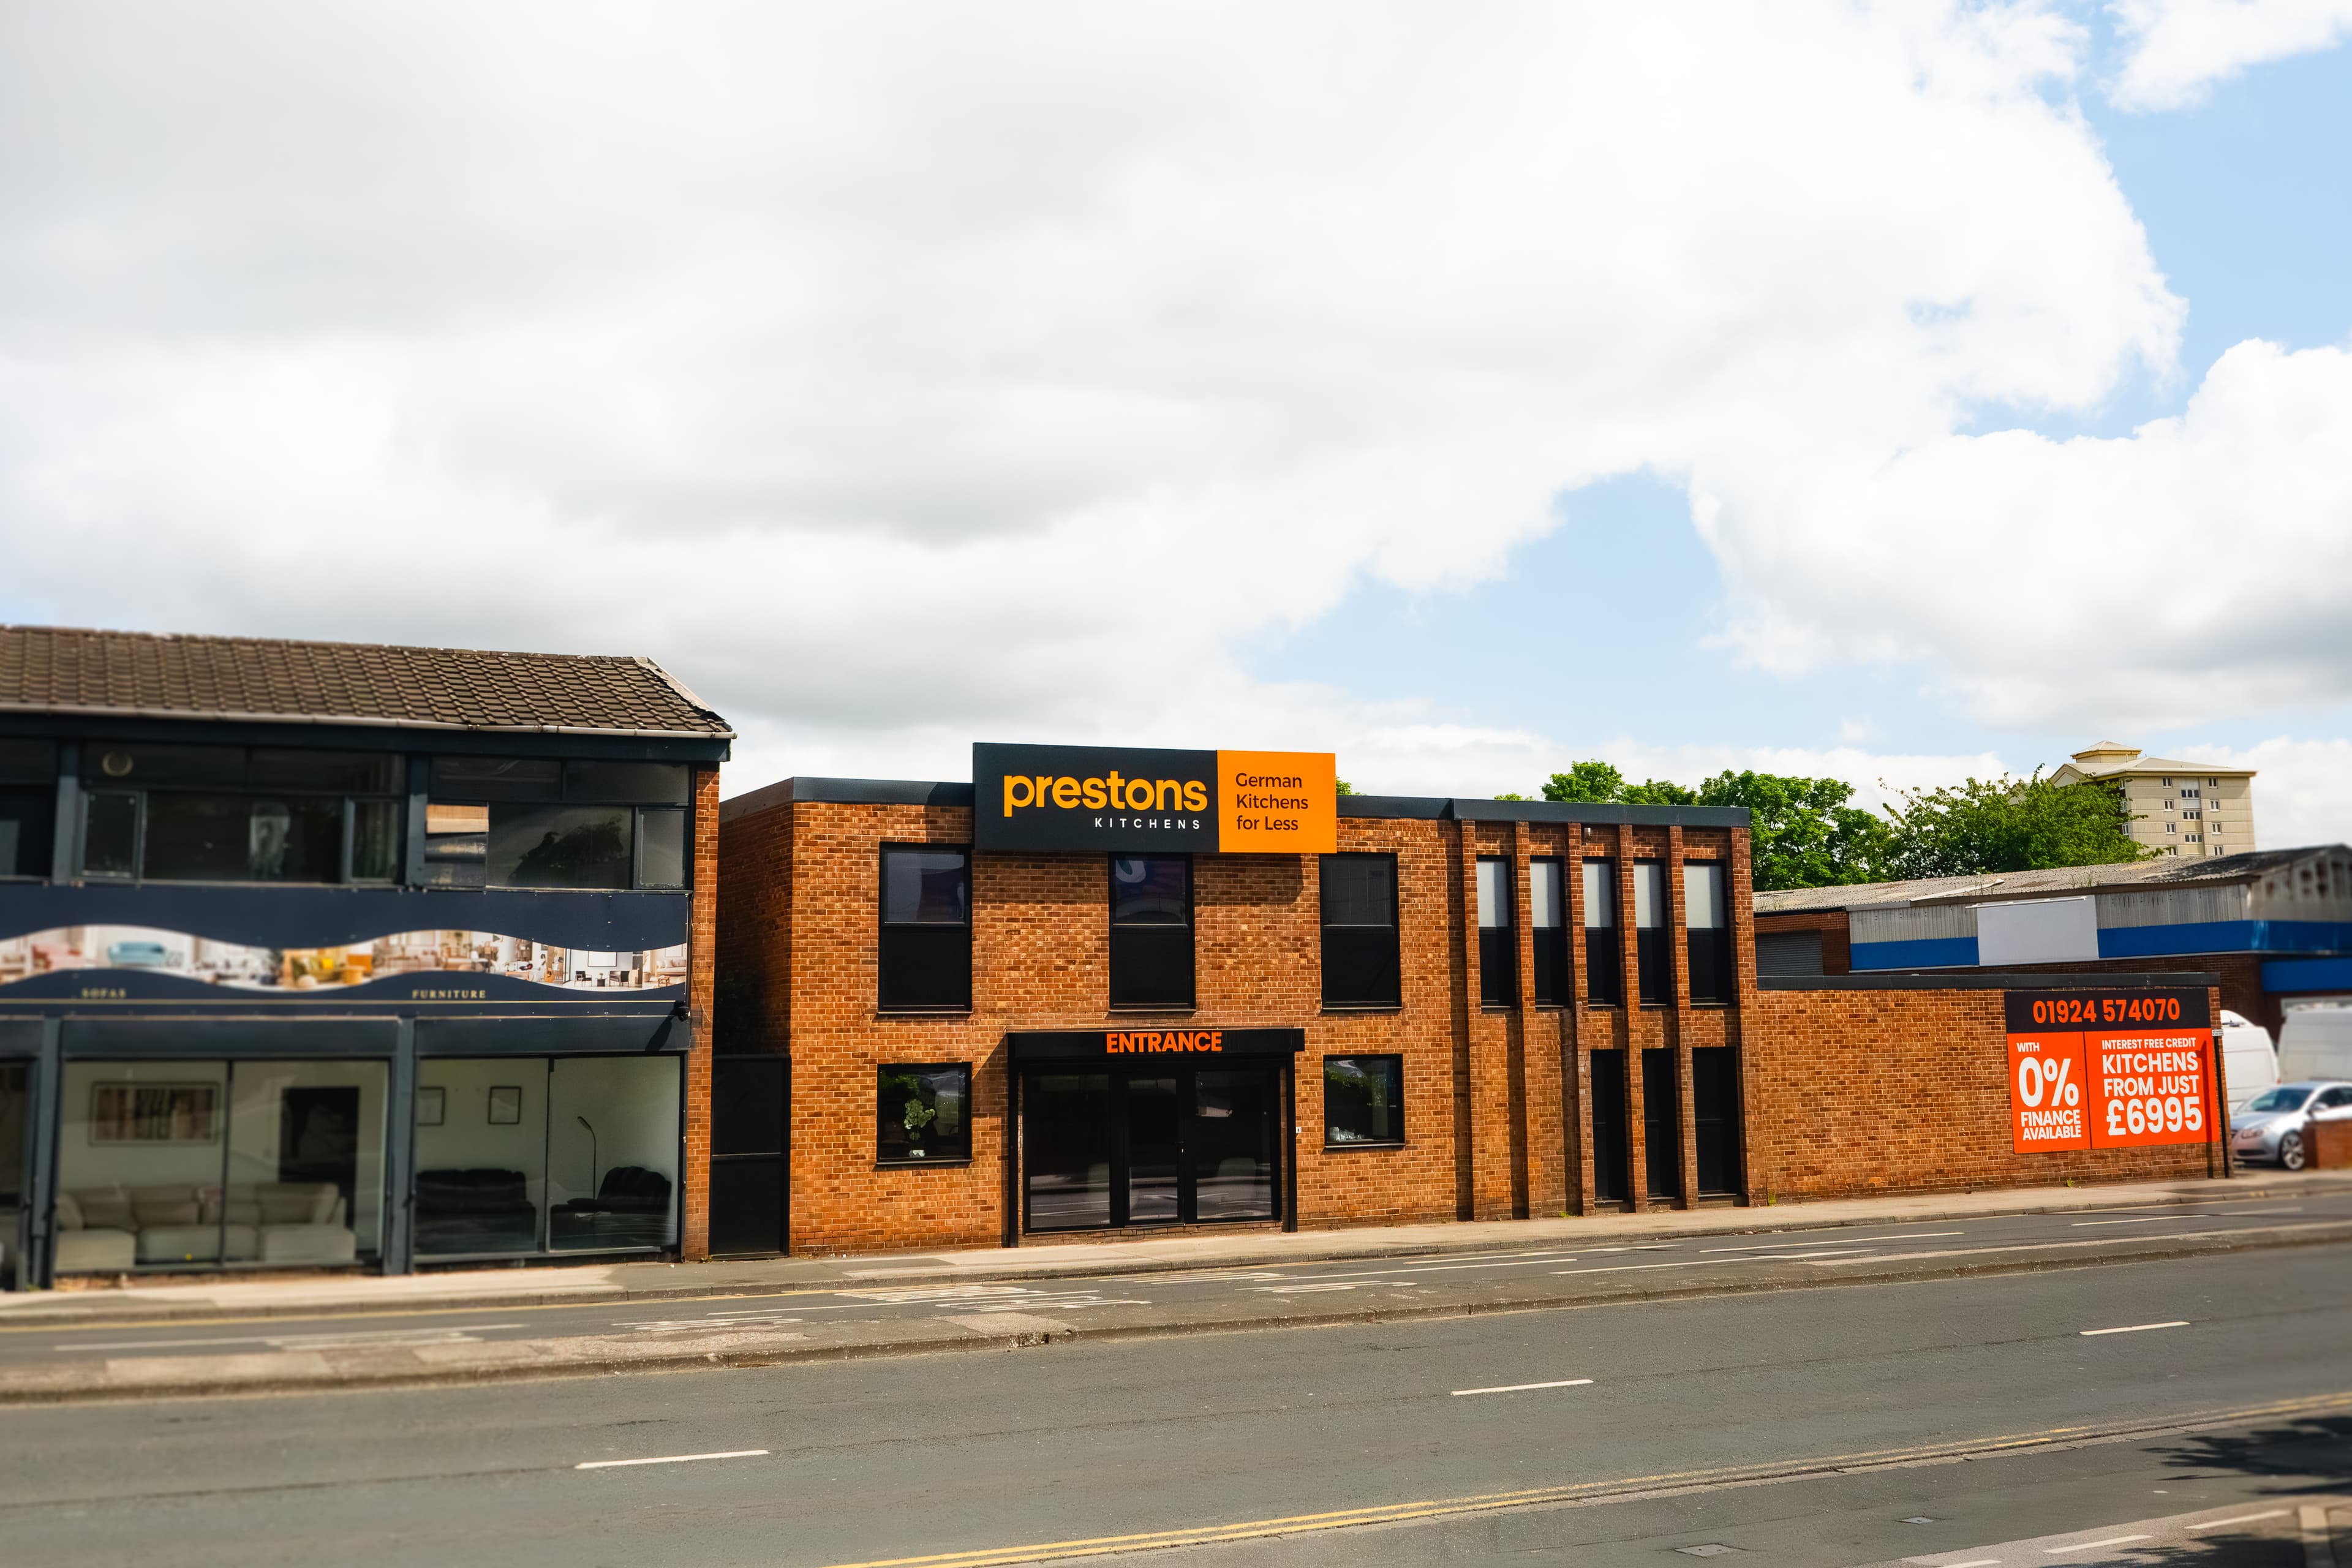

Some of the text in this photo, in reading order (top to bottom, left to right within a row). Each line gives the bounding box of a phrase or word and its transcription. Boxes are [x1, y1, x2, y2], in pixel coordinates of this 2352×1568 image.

[1236, 772, 1302, 788] German
[1004, 771, 1208, 817] prestons
[1237, 793, 1308, 809] Kitchens
[1095, 817, 1200, 829] KITCHENS
[1237, 815, 1298, 831] for Less
[81, 988, 126, 998] SOFAS
[412, 989, 486, 999] FURNITURE
[2033, 998, 2180, 1023] 01924 574070
[1106, 1031, 1223, 1054] ENTRANCE
[2016, 1042, 2040, 1052] WITH
[2101, 1037, 2196, 1050] INTEREST FREE CREDIT
[2102, 1051, 2198, 1074] KITCHENS
[2018, 1057, 2079, 1107] 0%
[2103, 1074, 2199, 1098] FROM JUST
[2021, 1109, 2081, 1128] FINANCE
[2106, 1095, 2203, 1136] £6995
[2022, 1125, 2082, 1140] AVAILABLE
